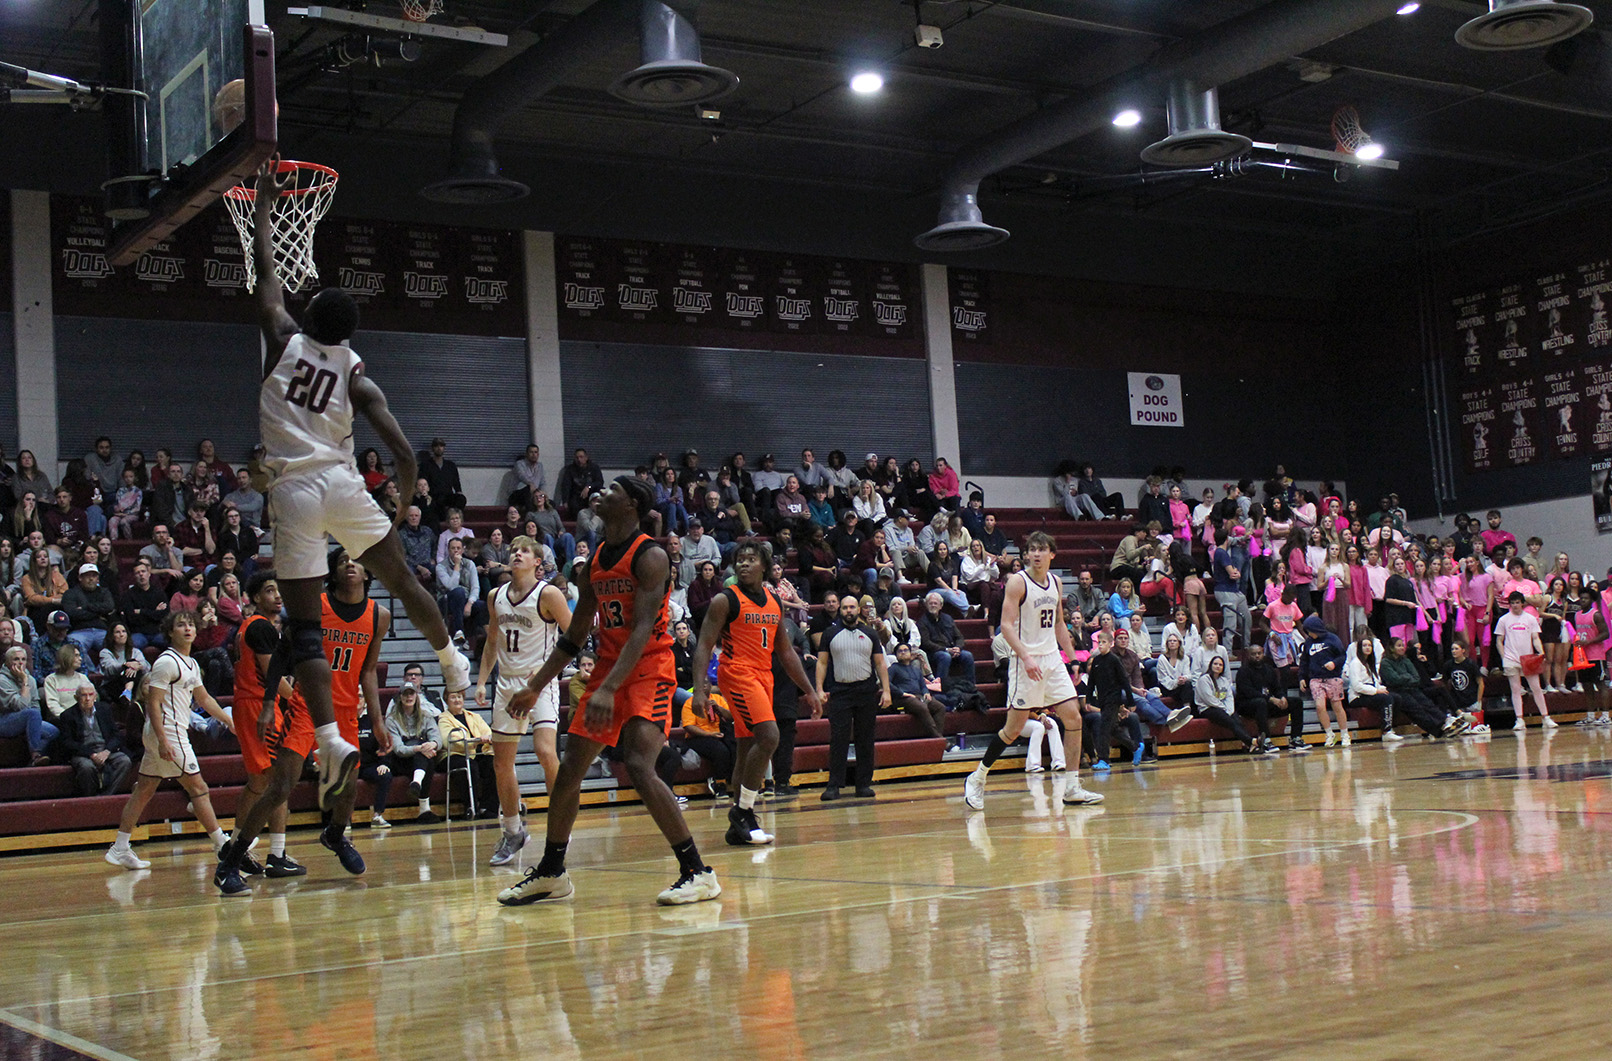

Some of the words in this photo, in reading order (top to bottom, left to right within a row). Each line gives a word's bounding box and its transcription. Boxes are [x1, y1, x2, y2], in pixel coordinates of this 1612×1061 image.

[351, 257, 372, 265] TENNIS
[415, 261, 434, 269] TRACK
[477, 265, 493, 273] TRACK
[679, 278, 703, 287] SOFTBALL
[1583, 270, 1605, 285] STATE
[738, 283, 749, 291] POM
[1542, 284, 1562, 298] STATE
[875, 292, 901, 301] VOLLEYBALL
[1500, 294, 1518, 308] STATE
[1537, 294, 1570, 312] CHAMPIONS
[1461, 304, 1479, 317] STATE
[1495, 305, 1526, 322] CHAMPIONS
[1456, 315, 1486, 330] CHAMPIONS
[1588, 320, 1608, 334] CROSS
[1541, 333, 1575, 351] WRESTLING
[1464, 355, 1481, 366] TRACK
[1497, 347, 1528, 361] WRESTLING
[285, 358, 338, 414] 20
[1550, 380, 1572, 394] STATE
[1143, 394, 1168, 406] DOG
[1507, 387, 1529, 401] STATE
[1544, 392, 1581, 408] CHAMPIONS
[1467, 398, 1488, 412] STATE
[1501, 397, 1537, 413] CHAMPIONS
[1136, 410, 1178, 422] POUND
[1462, 409, 1496, 425] CHAMPIONS
[1510, 436, 1532, 449] CROSS
[1555, 433, 1578, 446] TENNIS
[1473, 448, 1490, 461] GOLF
[1508, 446, 1536, 459] COUNTRY
[602, 600, 625, 630] 13
[744, 613, 779, 625] PIRATES
[1040, 609, 1054, 629] 23
[321, 628, 370, 646] PIRATES
[505, 629, 520, 653] 11
[760, 626, 768, 649] 1
[330, 646, 353, 673] 11
